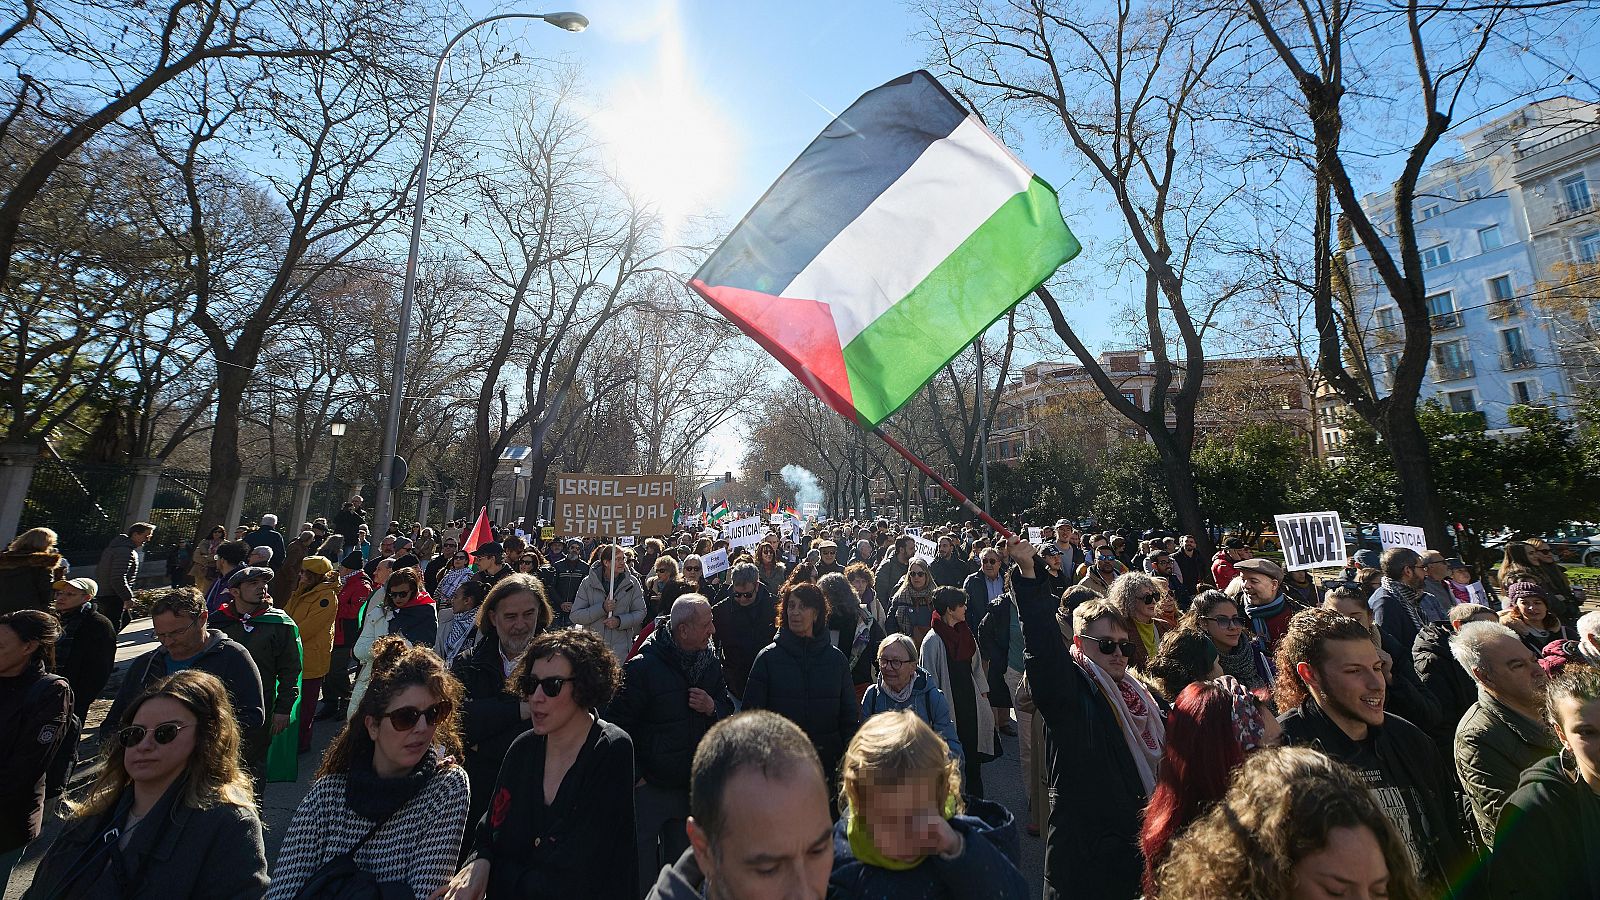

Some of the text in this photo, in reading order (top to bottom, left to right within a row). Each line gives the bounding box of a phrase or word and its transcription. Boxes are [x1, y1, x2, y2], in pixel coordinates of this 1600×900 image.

[559, 478, 673, 497] ISRAEL=USA
[563, 518, 642, 535] STATES
[1277, 516, 1343, 566] PEACE!
[1382, 530, 1426, 548] JUSTICIA!
